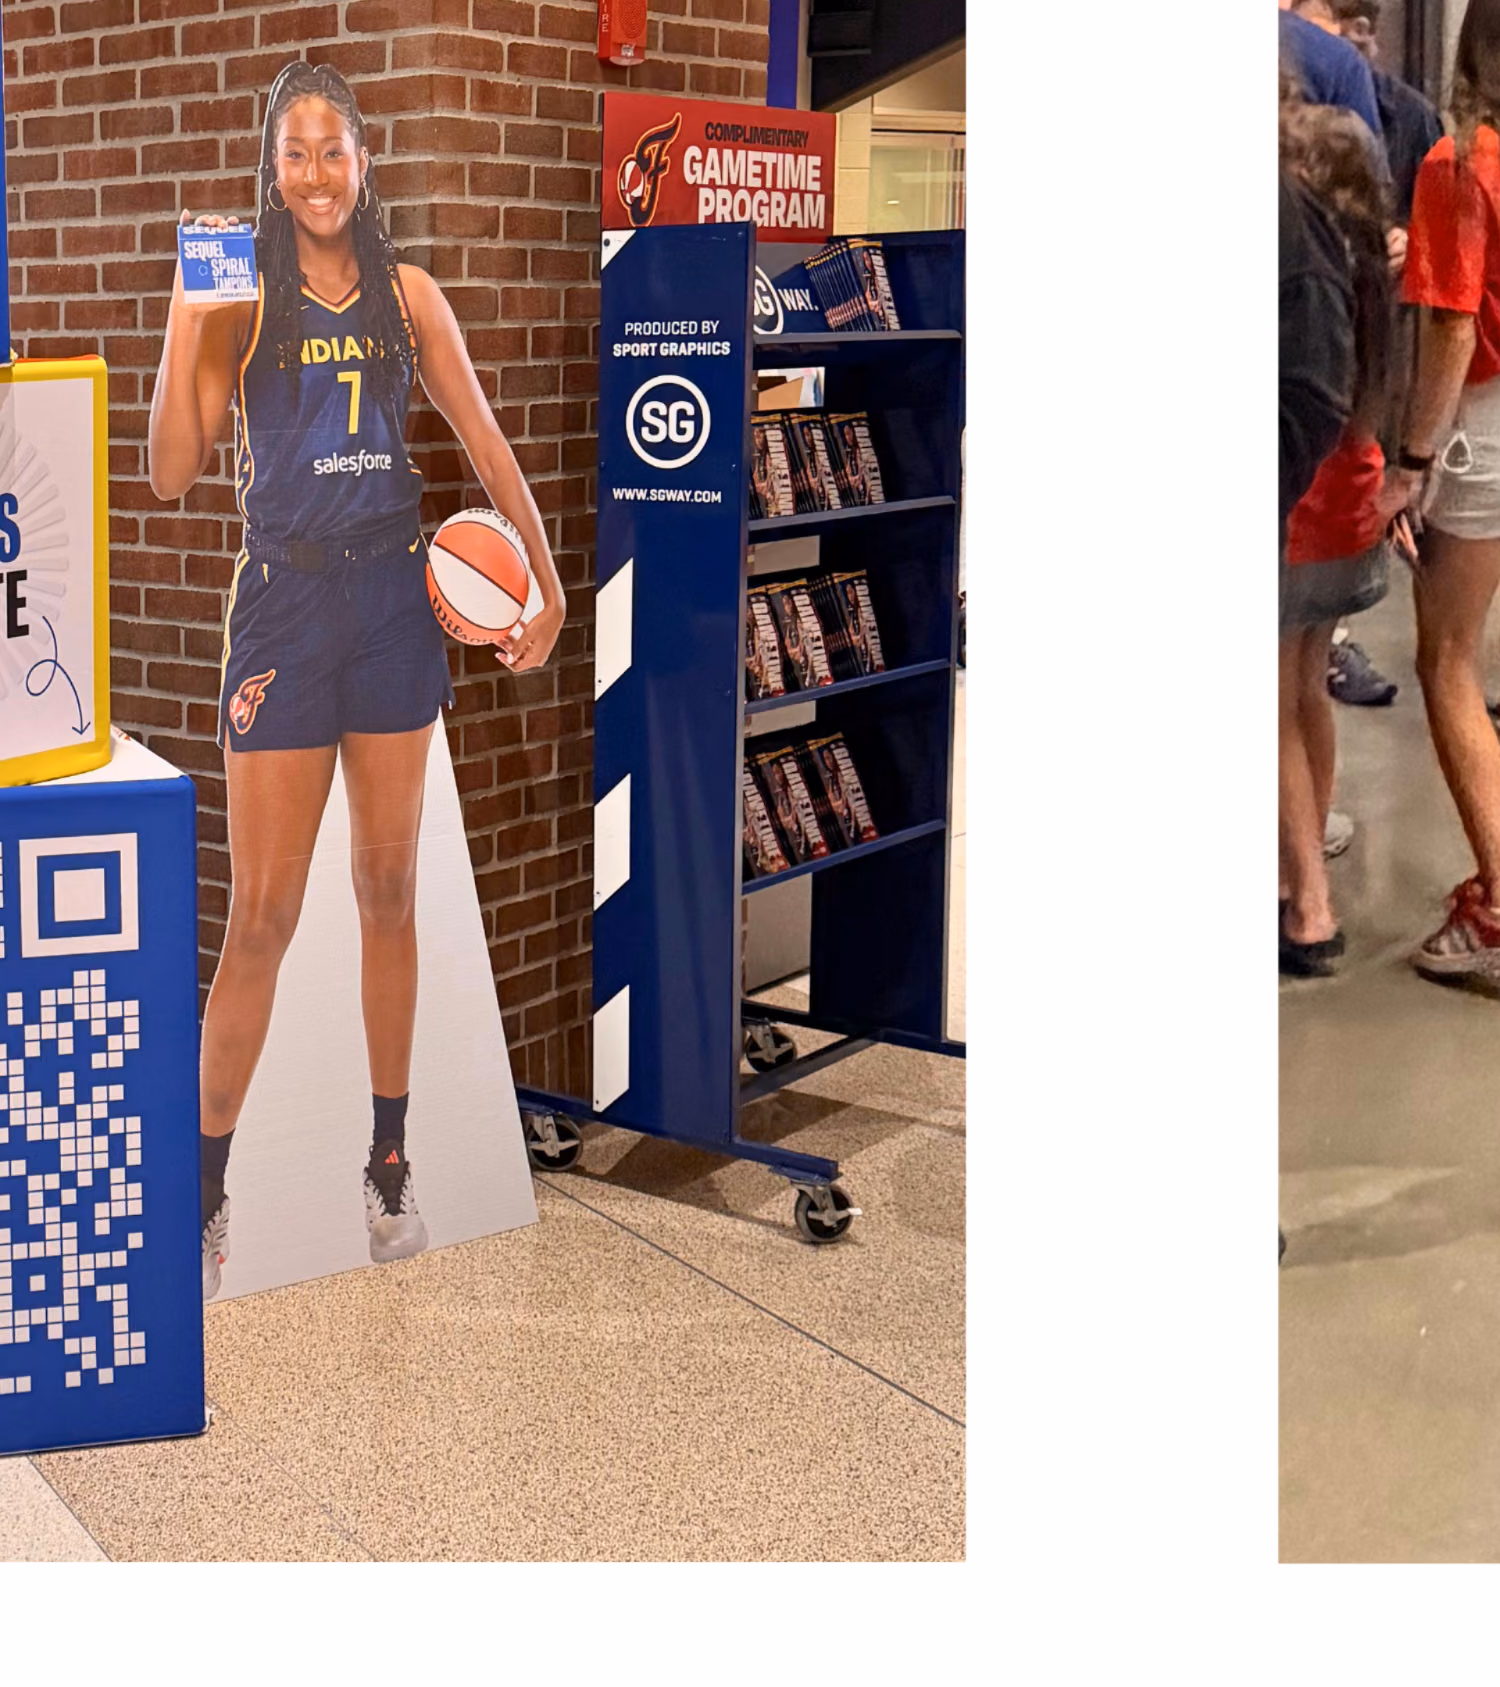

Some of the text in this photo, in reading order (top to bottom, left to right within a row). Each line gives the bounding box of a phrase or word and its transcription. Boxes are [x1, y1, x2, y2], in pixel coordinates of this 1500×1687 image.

[704, 121, 809, 149] COMPLIMENTARY
[683, 145, 822, 192] GAMETIME
[699, 189, 826, 229] PROGRAM
[184, 240, 226, 262] SEQUEL
[211, 257, 253, 277] SPIRAL
[778, 287, 819, 312] WAY.
[624, 319, 720, 337] PRODUCED BY
[612, 340, 731, 358] SPORT GRAPHICS
[337, 370, 362, 435] 7
[640, 399, 696, 444] SG
[313, 448, 392, 477] salesforce
[612, 487, 722, 505] WWW.SGWAY.COM
